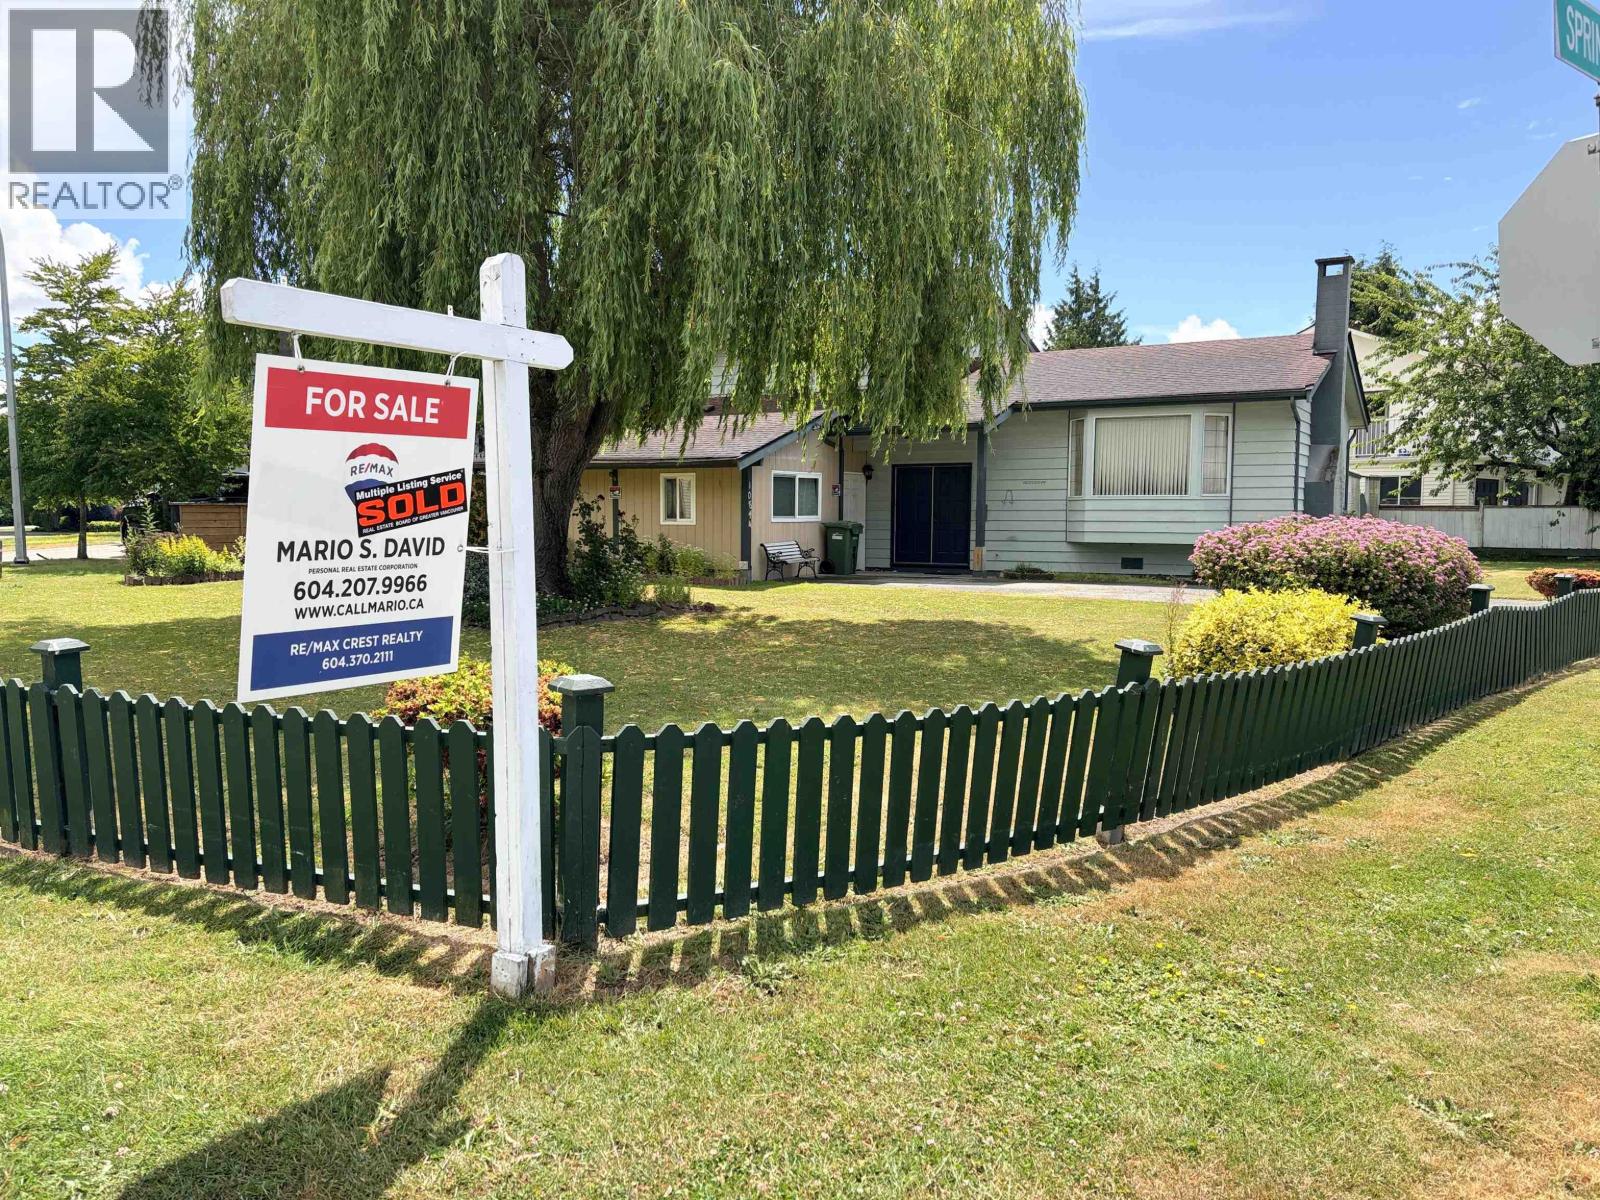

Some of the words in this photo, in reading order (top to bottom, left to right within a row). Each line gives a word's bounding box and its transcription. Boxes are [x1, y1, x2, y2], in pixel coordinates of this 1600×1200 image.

[305, 386, 366, 418] FOR
[373, 393, 441, 424] SALE
[350, 462, 394, 478] RE/MAX
[356, 486, 395, 500] Multiple
[397, 478, 428, 491] Listing
[430, 471, 462, 485] Service
[357, 481, 466, 527] SOLD
[376, 522, 394, 531] ESTATE
[395, 518, 412, 527] BOARD
[412, 515, 419, 523] OF
[419, 512, 440, 521] GREATER
[440, 505, 464, 515] VANCOUVER
[277, 539, 354, 563] MARIO
[359, 539, 377, 559] S.
[384, 537, 445, 558] DAVID
[308, 567, 340, 575] PERSONAL
[357, 564, 378, 572] ESTATE
[379, 563, 418, 571] CORPORATION
[293, 574, 428, 601] 604.207.9966
[294, 598, 424, 620] WWW.CALLMARIO.CA
[290, 639, 340, 657] RE/MAX
[342, 635, 379, 651] CREST
[381, 630, 423, 645] REALTY
[322, 650, 394, 670] 604.370.2111
